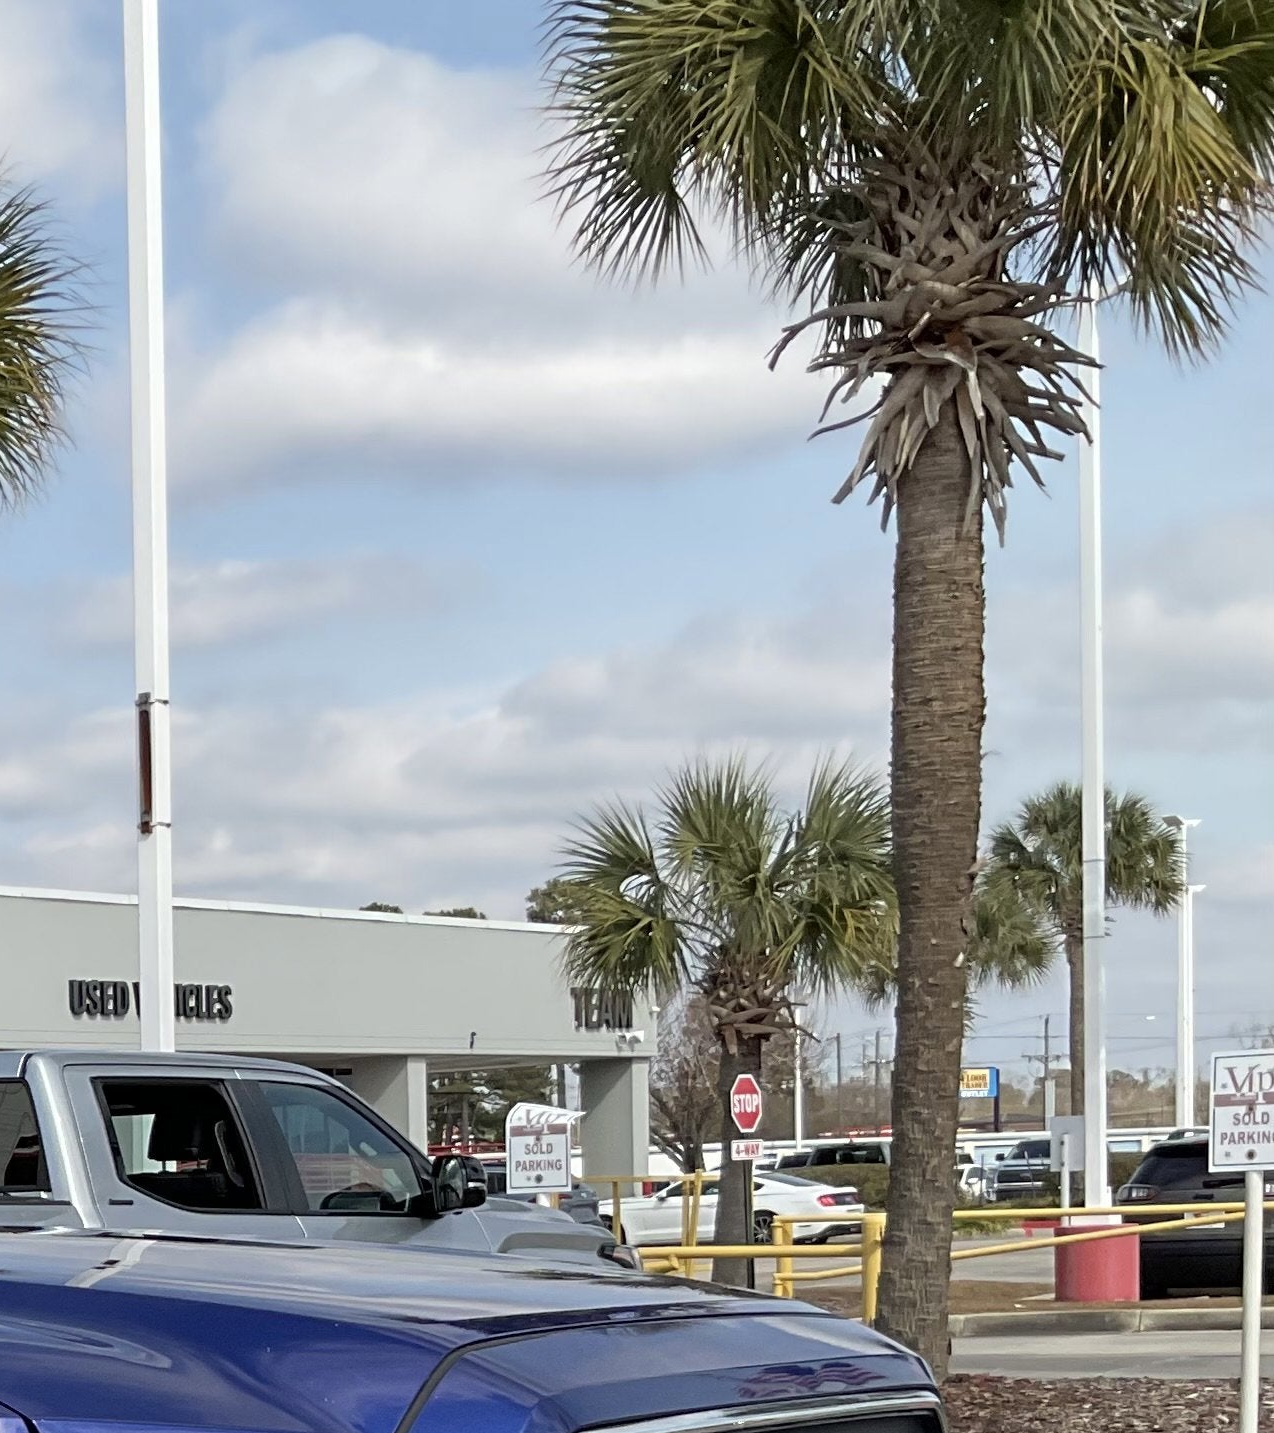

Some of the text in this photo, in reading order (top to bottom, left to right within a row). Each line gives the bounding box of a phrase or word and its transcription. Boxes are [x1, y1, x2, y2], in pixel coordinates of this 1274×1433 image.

[68, 979, 233, 1020] USED VICLES
[570, 986, 633, 1030] TEAM
[733, 1093, 759, 1113] STOP
[1233, 1112, 1270, 1126] SOLD
[524, 1142, 554, 1155] SOLD
[735, 1142, 760, 1156] 4-WAY
[515, 1159, 563, 1172] PARKING
